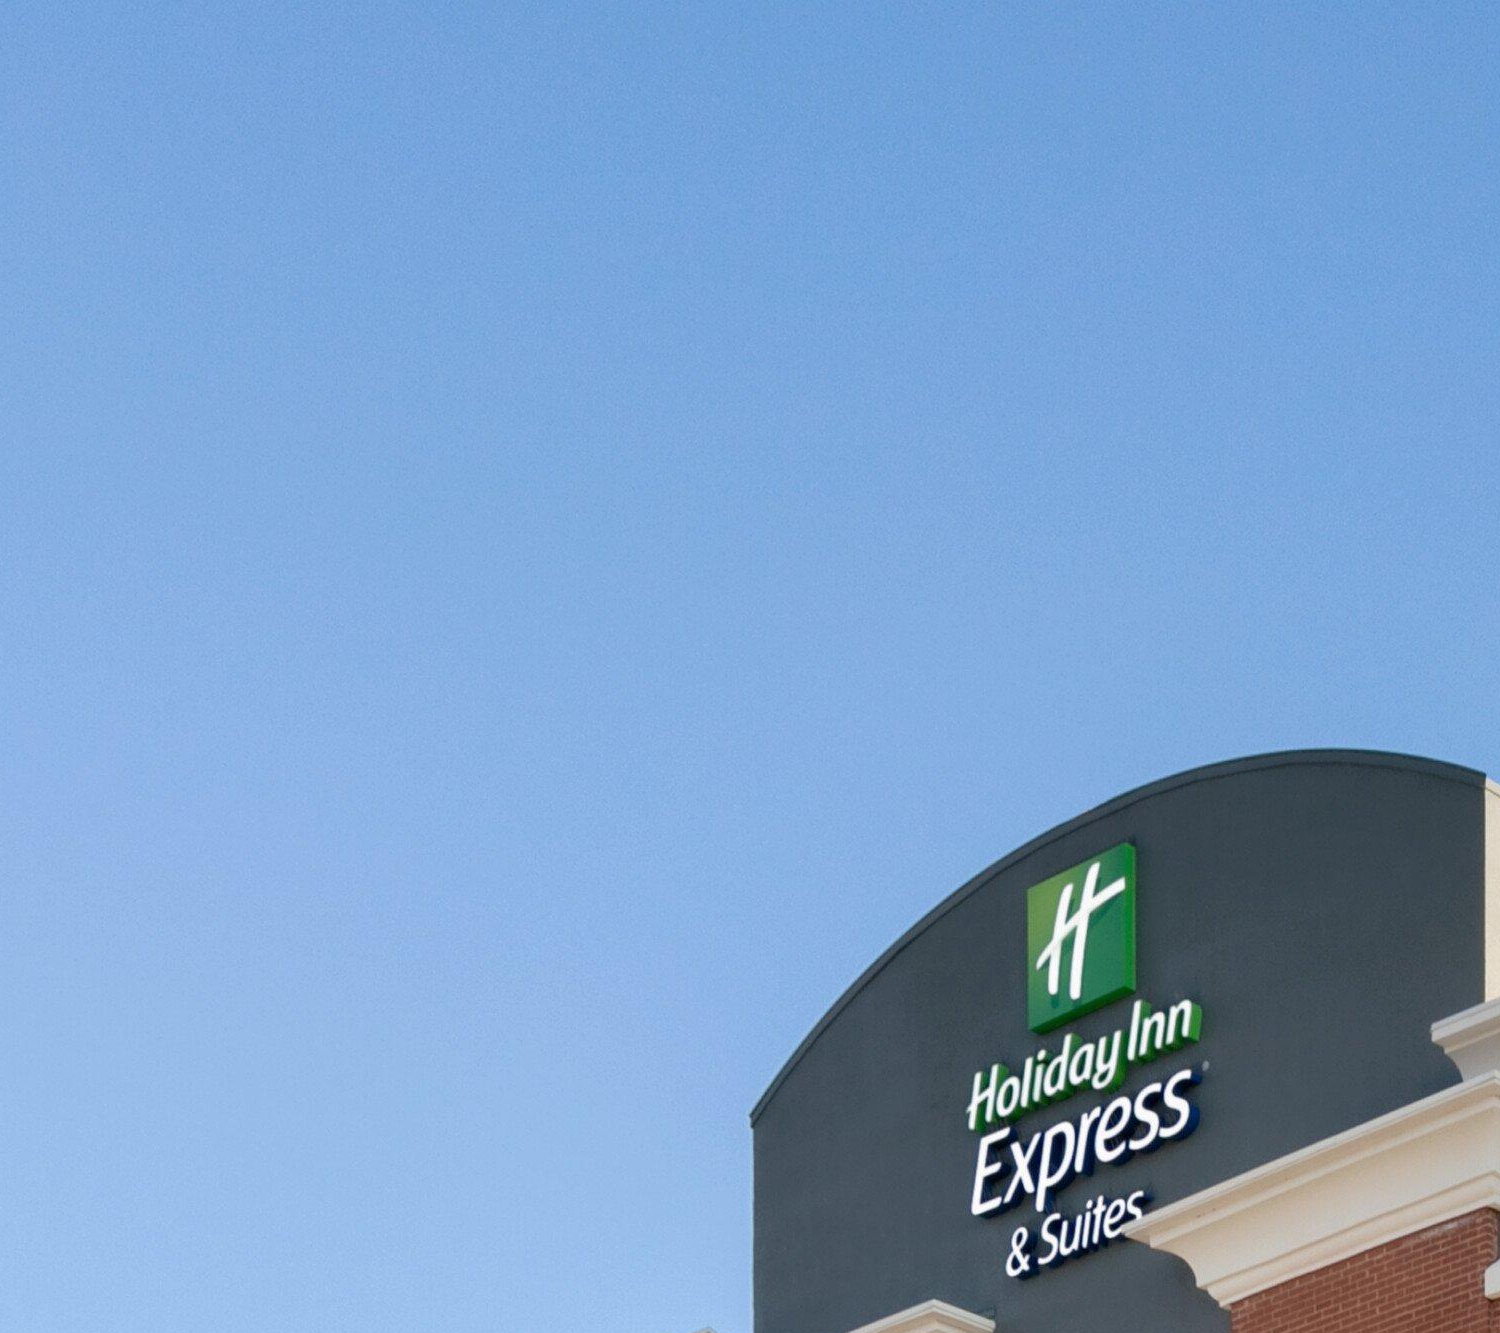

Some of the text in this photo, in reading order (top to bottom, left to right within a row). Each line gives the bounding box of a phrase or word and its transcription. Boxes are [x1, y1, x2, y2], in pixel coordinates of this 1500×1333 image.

[966, 1000, 1192, 1130] Holiday Inn
[971, 1069, 1192, 1216] Express
[1005, 1190, 1144, 1277] & Suites
